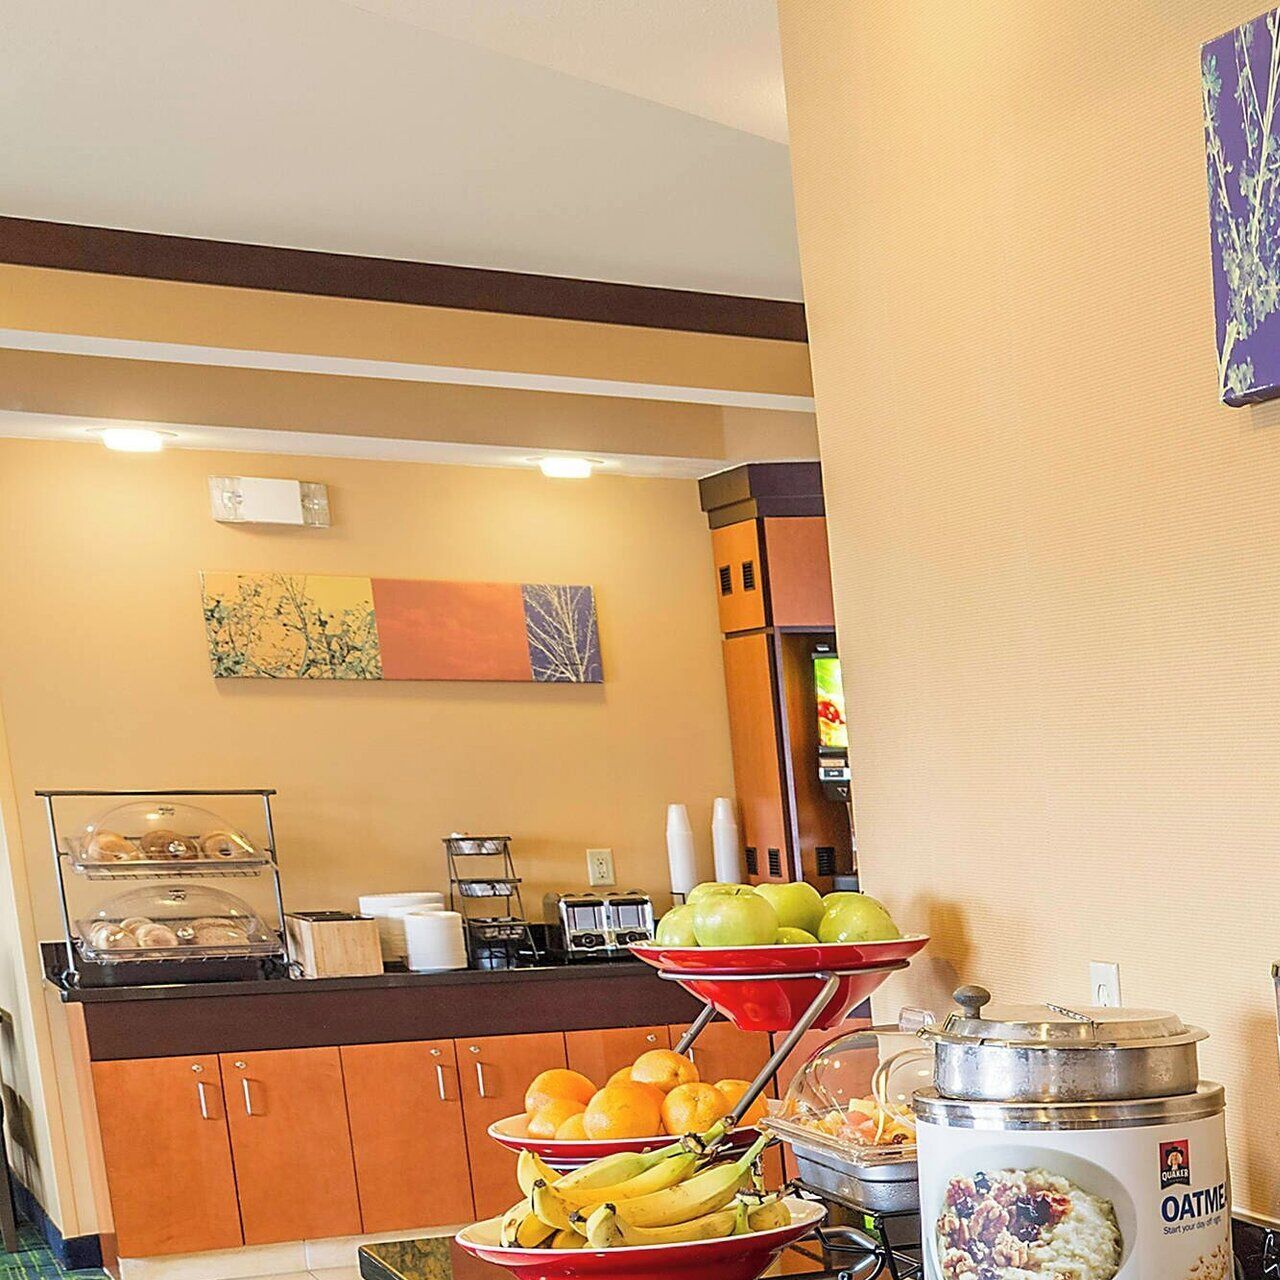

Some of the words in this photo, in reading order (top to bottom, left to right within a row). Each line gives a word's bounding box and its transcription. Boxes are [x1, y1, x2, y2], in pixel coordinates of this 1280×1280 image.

[1162, 1168, 1189, 1181] QUAKER
[1161, 1182, 1227, 1222] OATME
[1163, 1224, 1182, 1235] Start
[1182, 1223, 1196, 1234] your
